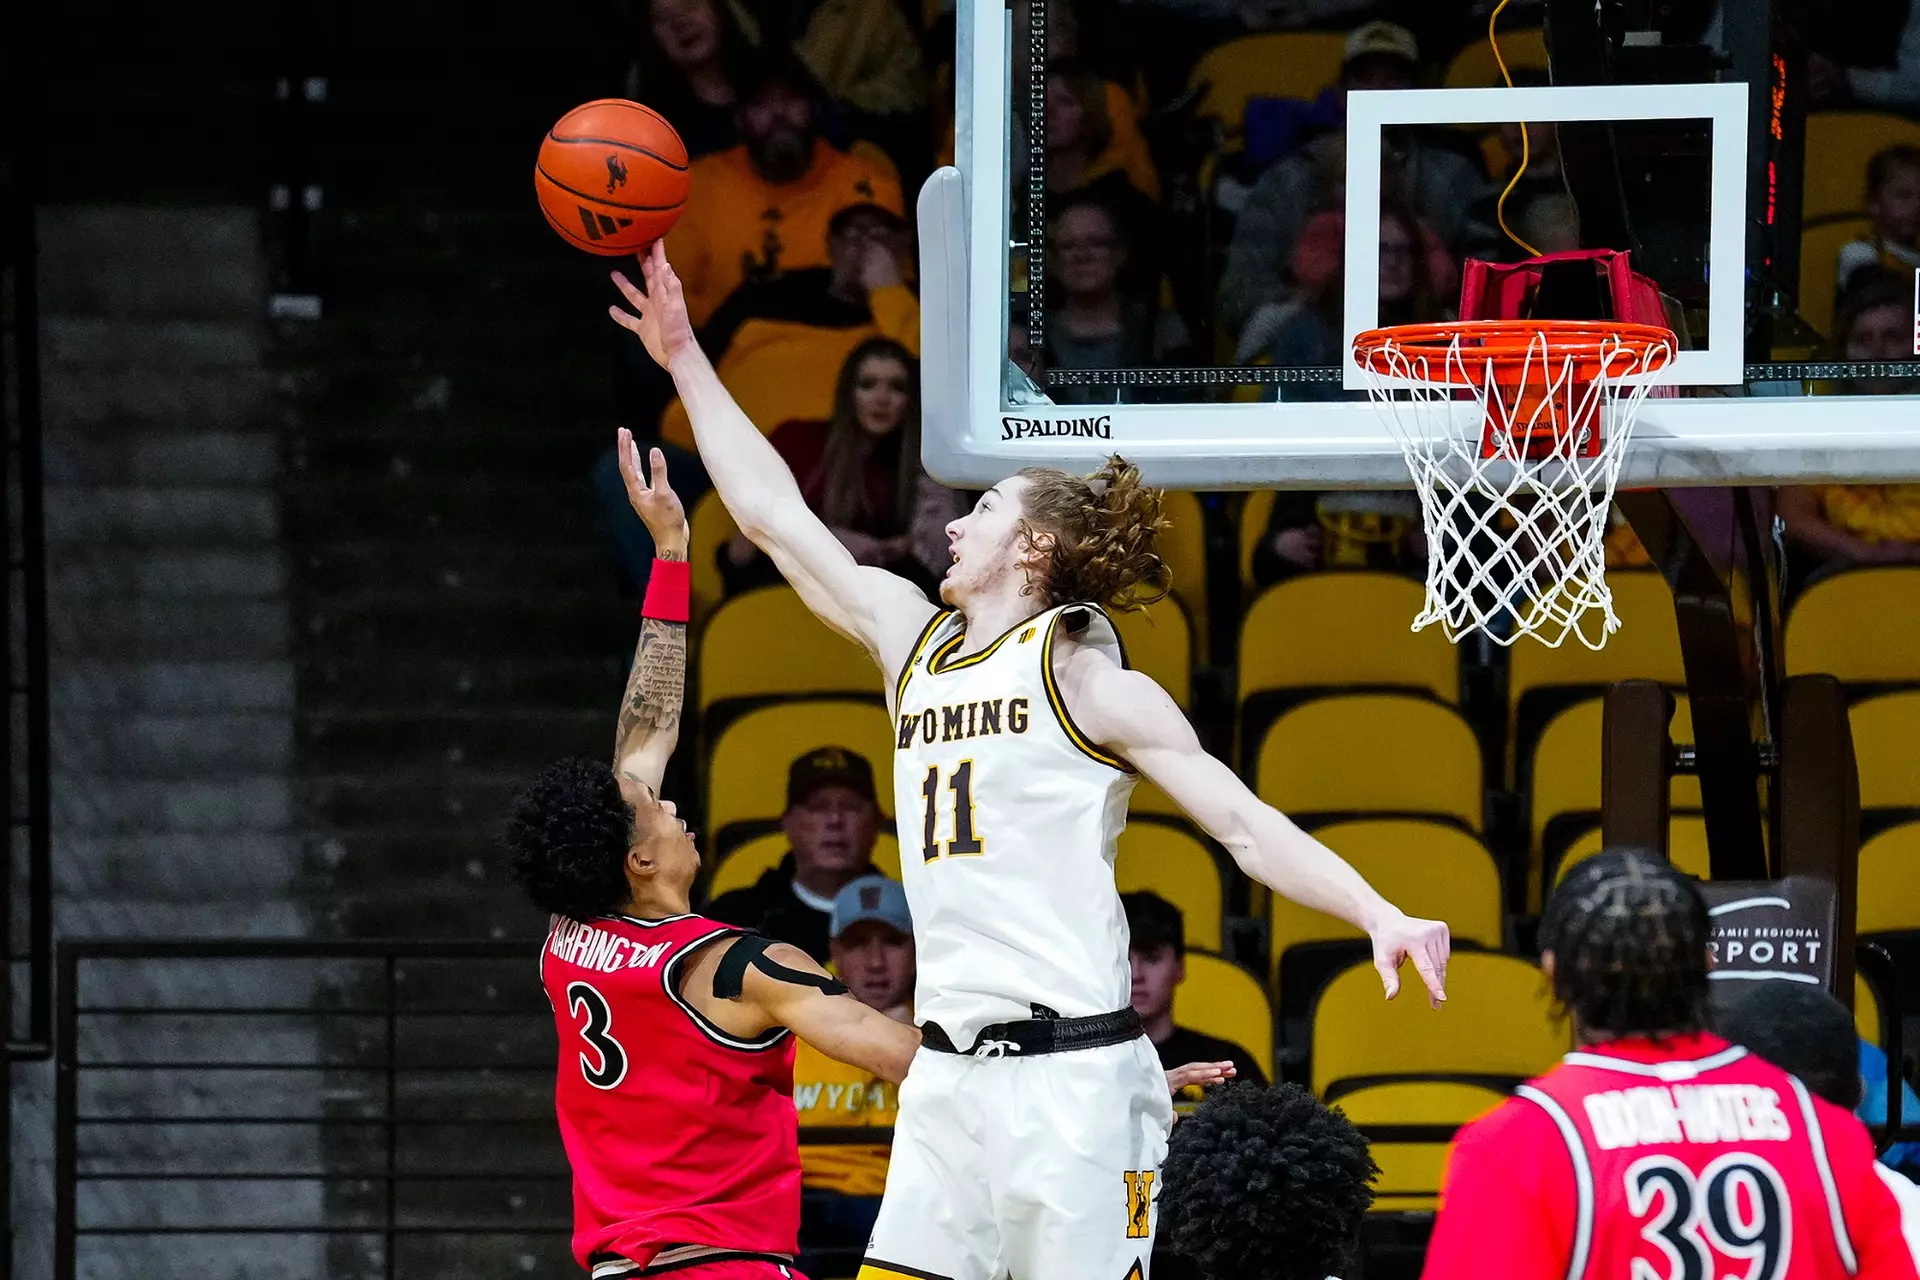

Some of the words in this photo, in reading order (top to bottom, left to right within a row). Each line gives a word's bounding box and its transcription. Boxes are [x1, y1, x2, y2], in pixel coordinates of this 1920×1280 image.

[1001, 415, 1111, 441] SPALDING
[1516, 421, 1558, 432] SPLDIN
[922, 758, 984, 865] 11
[1754, 927, 1820, 939] REGIONAL
[566, 980, 629, 1090] 3
[1623, 1151, 1793, 1280] 39
